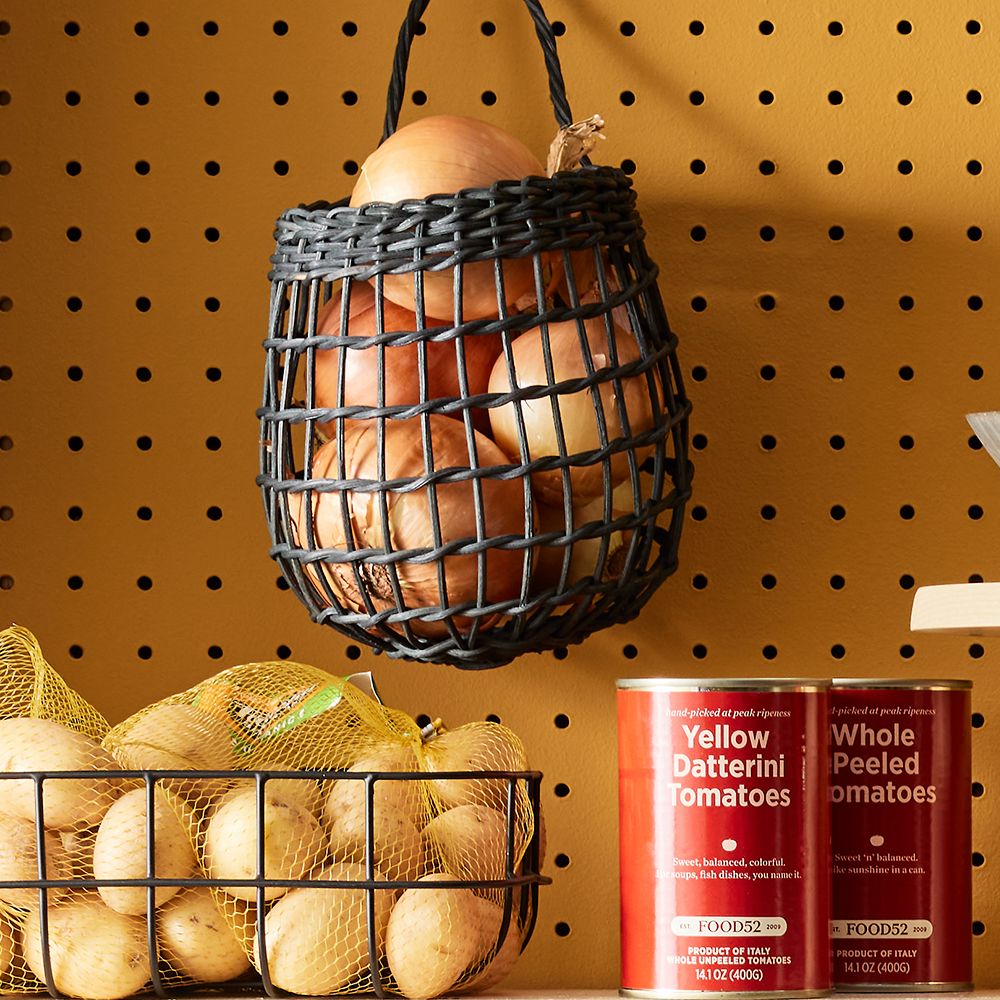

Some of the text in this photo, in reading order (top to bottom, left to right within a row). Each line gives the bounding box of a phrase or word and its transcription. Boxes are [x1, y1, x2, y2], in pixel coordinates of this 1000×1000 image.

[666, 708, 791, 719] hand-picked at peak ripeness
[869, 707, 879, 715] at
[880, 706, 902, 717] peak
[903, 706, 936, 717] ripeness
[682, 724, 770, 749] Yellow
[831, 723, 915, 747] Whole
[673, 754, 784, 778] Datterini
[833, 751, 919, 775] Peeled
[667, 783, 790, 807] Tomatoes
[831, 781, 937, 804] omatoes
[673, 858, 785, 867] Sweet, balanced, colorful.
[834, 853, 861, 862] Sweet
[876, 853, 919, 862] balanced.
[671, 872, 698, 880] soups,
[700, 870, 716, 879] fish
[719, 870, 751, 880] dishes,
[752, 872, 769, 880] you
[793, 871, 802, 879] it.
[833, 866, 847, 874] ike
[848, 865, 890, 874] sunshine
[891, 865, 901, 874] in
[699, 920, 761, 932] FOOD52
[847, 923, 908, 936] FOOD52
[688, 947, 771, 956] PRODUCT OF ITALY
[837, 949, 918, 958] PRODUCT OF ITALY
[667, 956, 792, 965] WHOLE UNPEELED TOMATOES
[844, 961, 910, 974] 14.1 OZ (400G)
[695, 968, 763, 982] 14.1 OZ (400G)
